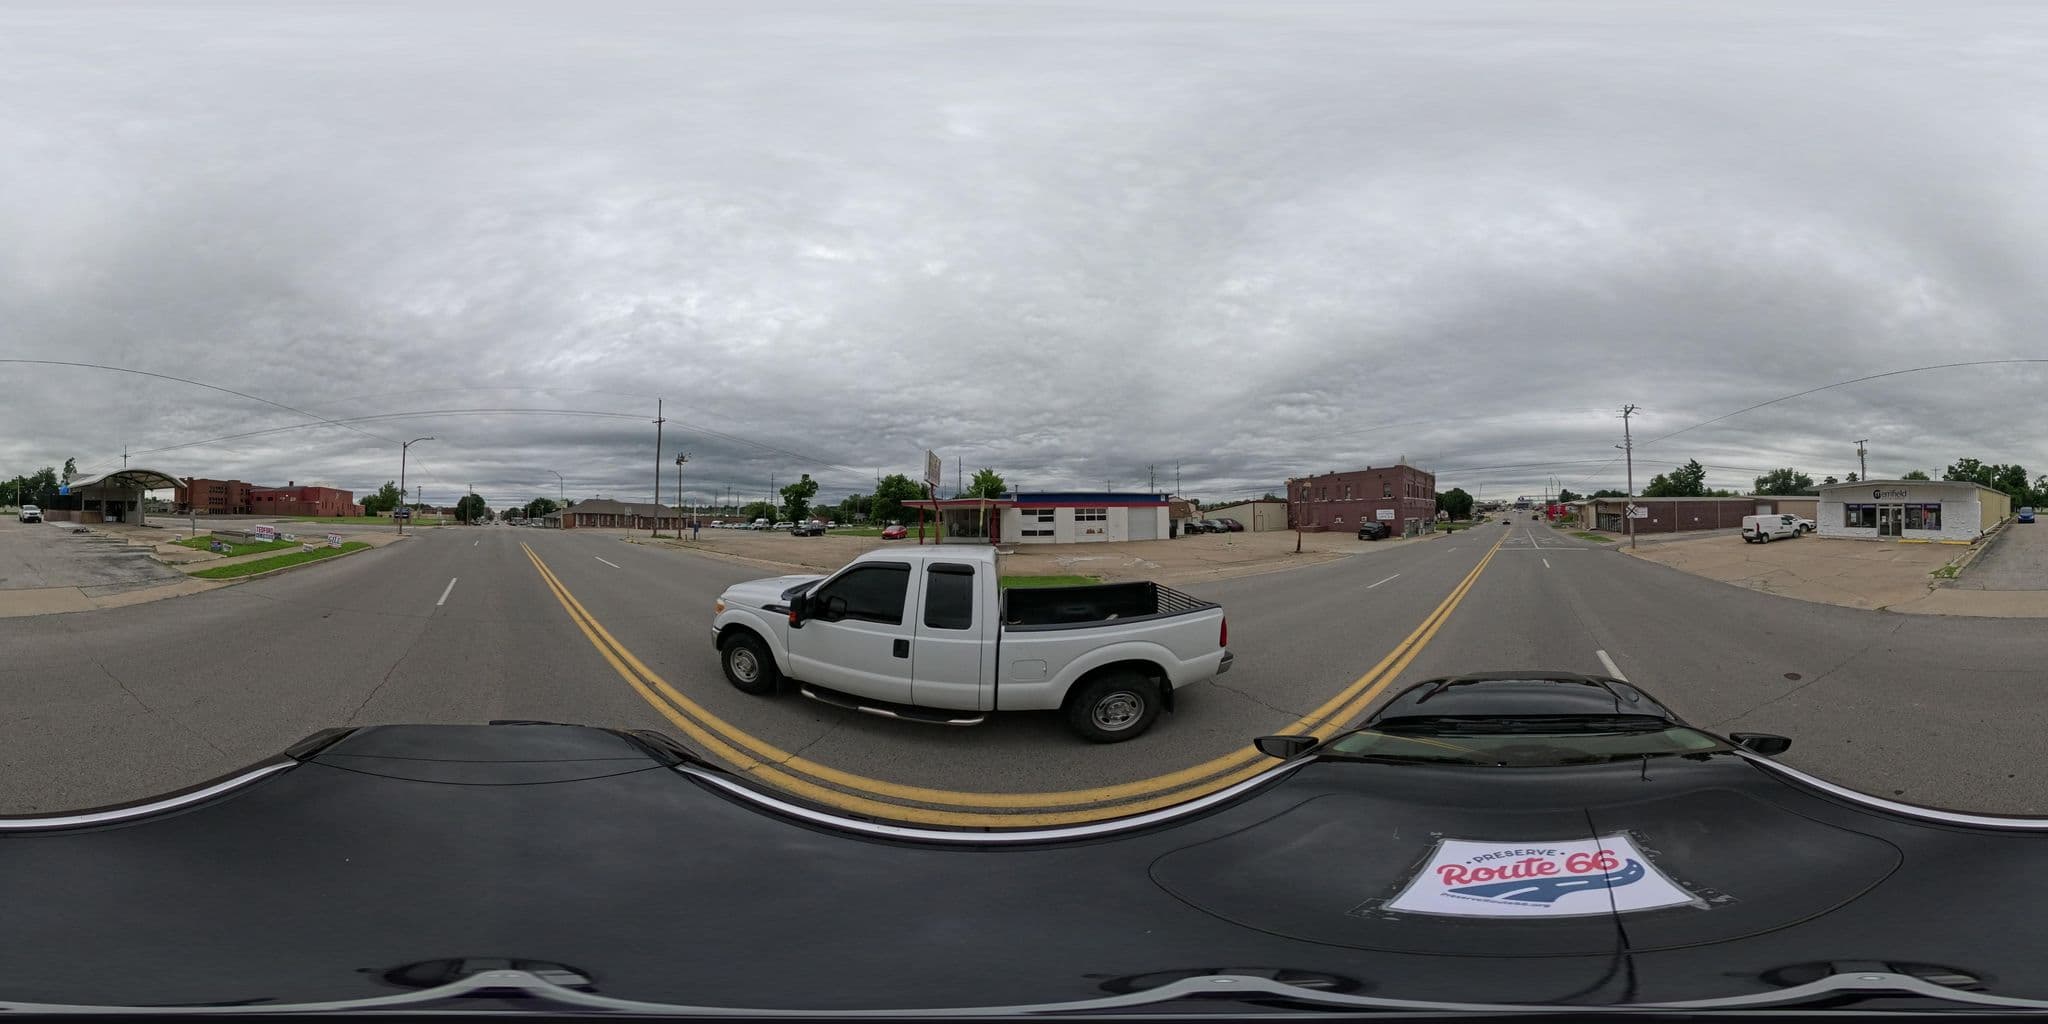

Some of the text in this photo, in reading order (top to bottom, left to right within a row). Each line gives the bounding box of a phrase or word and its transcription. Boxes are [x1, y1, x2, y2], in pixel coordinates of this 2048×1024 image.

[1437, 849, 1620, 886] Route 66
[1472, 849, 1557, 863] PRESERVE
